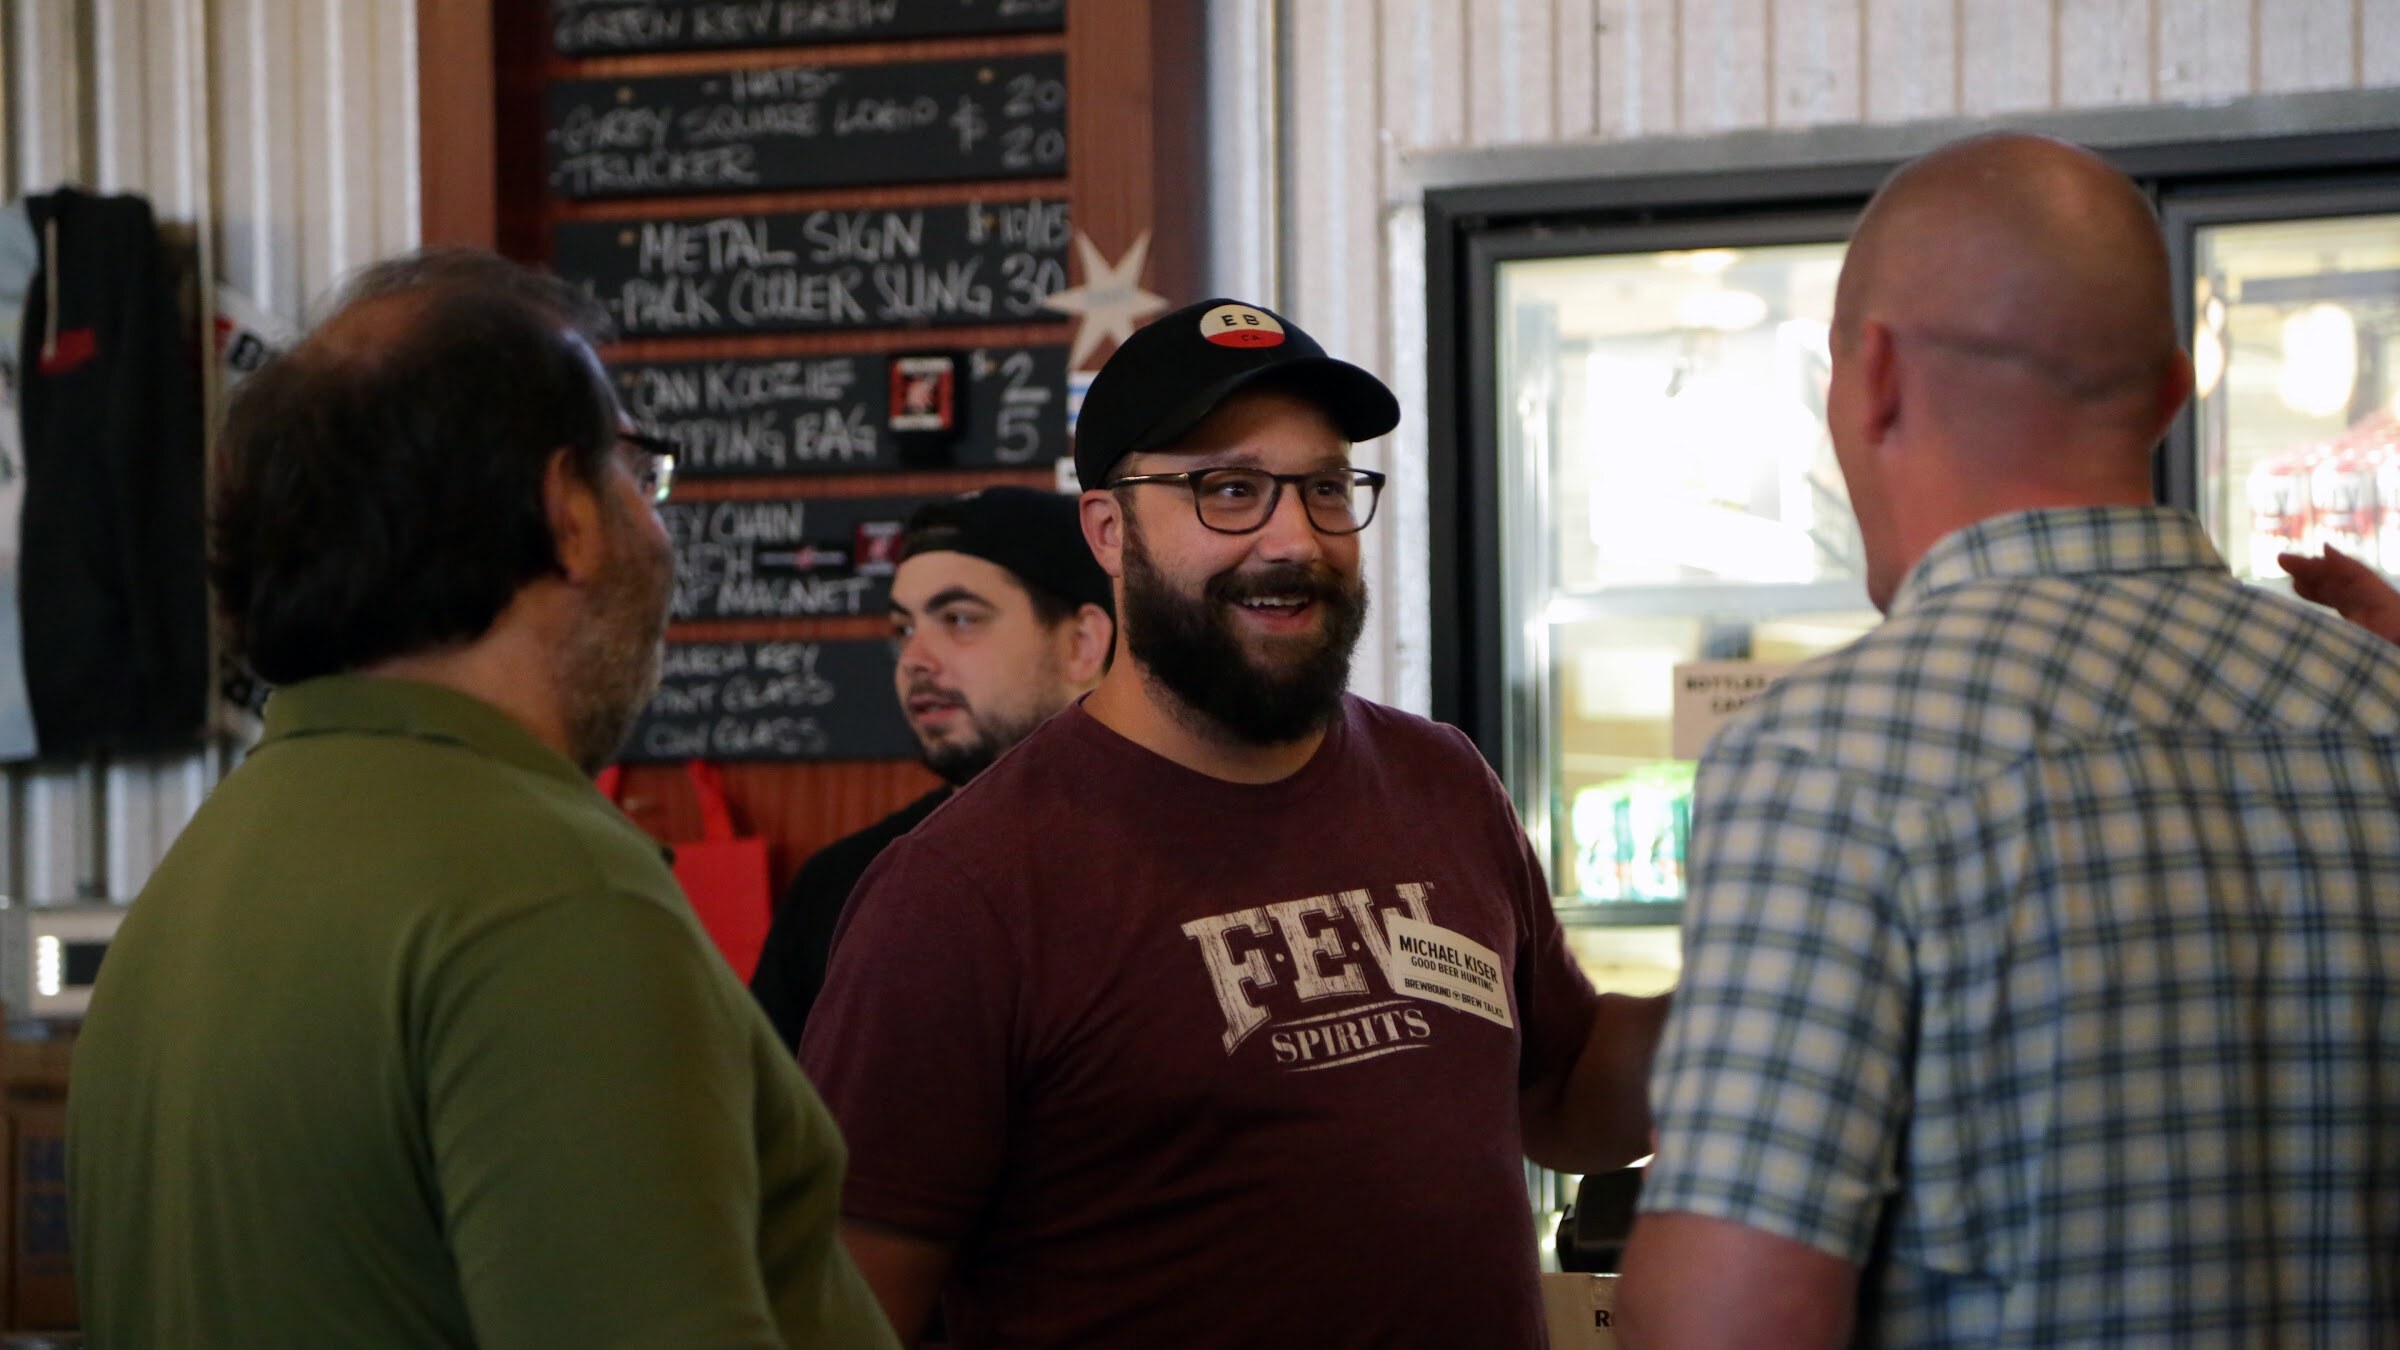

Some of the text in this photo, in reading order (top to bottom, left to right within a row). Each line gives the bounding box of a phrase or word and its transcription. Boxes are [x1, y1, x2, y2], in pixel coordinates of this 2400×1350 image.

[1002, 73, 1067, 118] 20
[1002, 126, 1067, 169] 20
[638, 214, 798, 275] METAL
[802, 207, 924, 263] SIGN
[871, 254, 993, 322] SLING
[1001, 252, 1067, 317] 30
[704, 358, 856, 413] KOOZIE
[1000, 351, 1051, 404] 2
[795, 403, 877, 461] BAG
[996, 406, 1042, 464] 5
[710, 500, 804, 544] CHAIN
[1399, 935, 1499, 985] MICHAEL KISER
[1411, 956, 1494, 993] GOOD BEER HUNTING
[1405, 978, 1504, 1019] BREWBOUND BREW TALKS
[1271, 1008, 1432, 1064] SPIRITS
